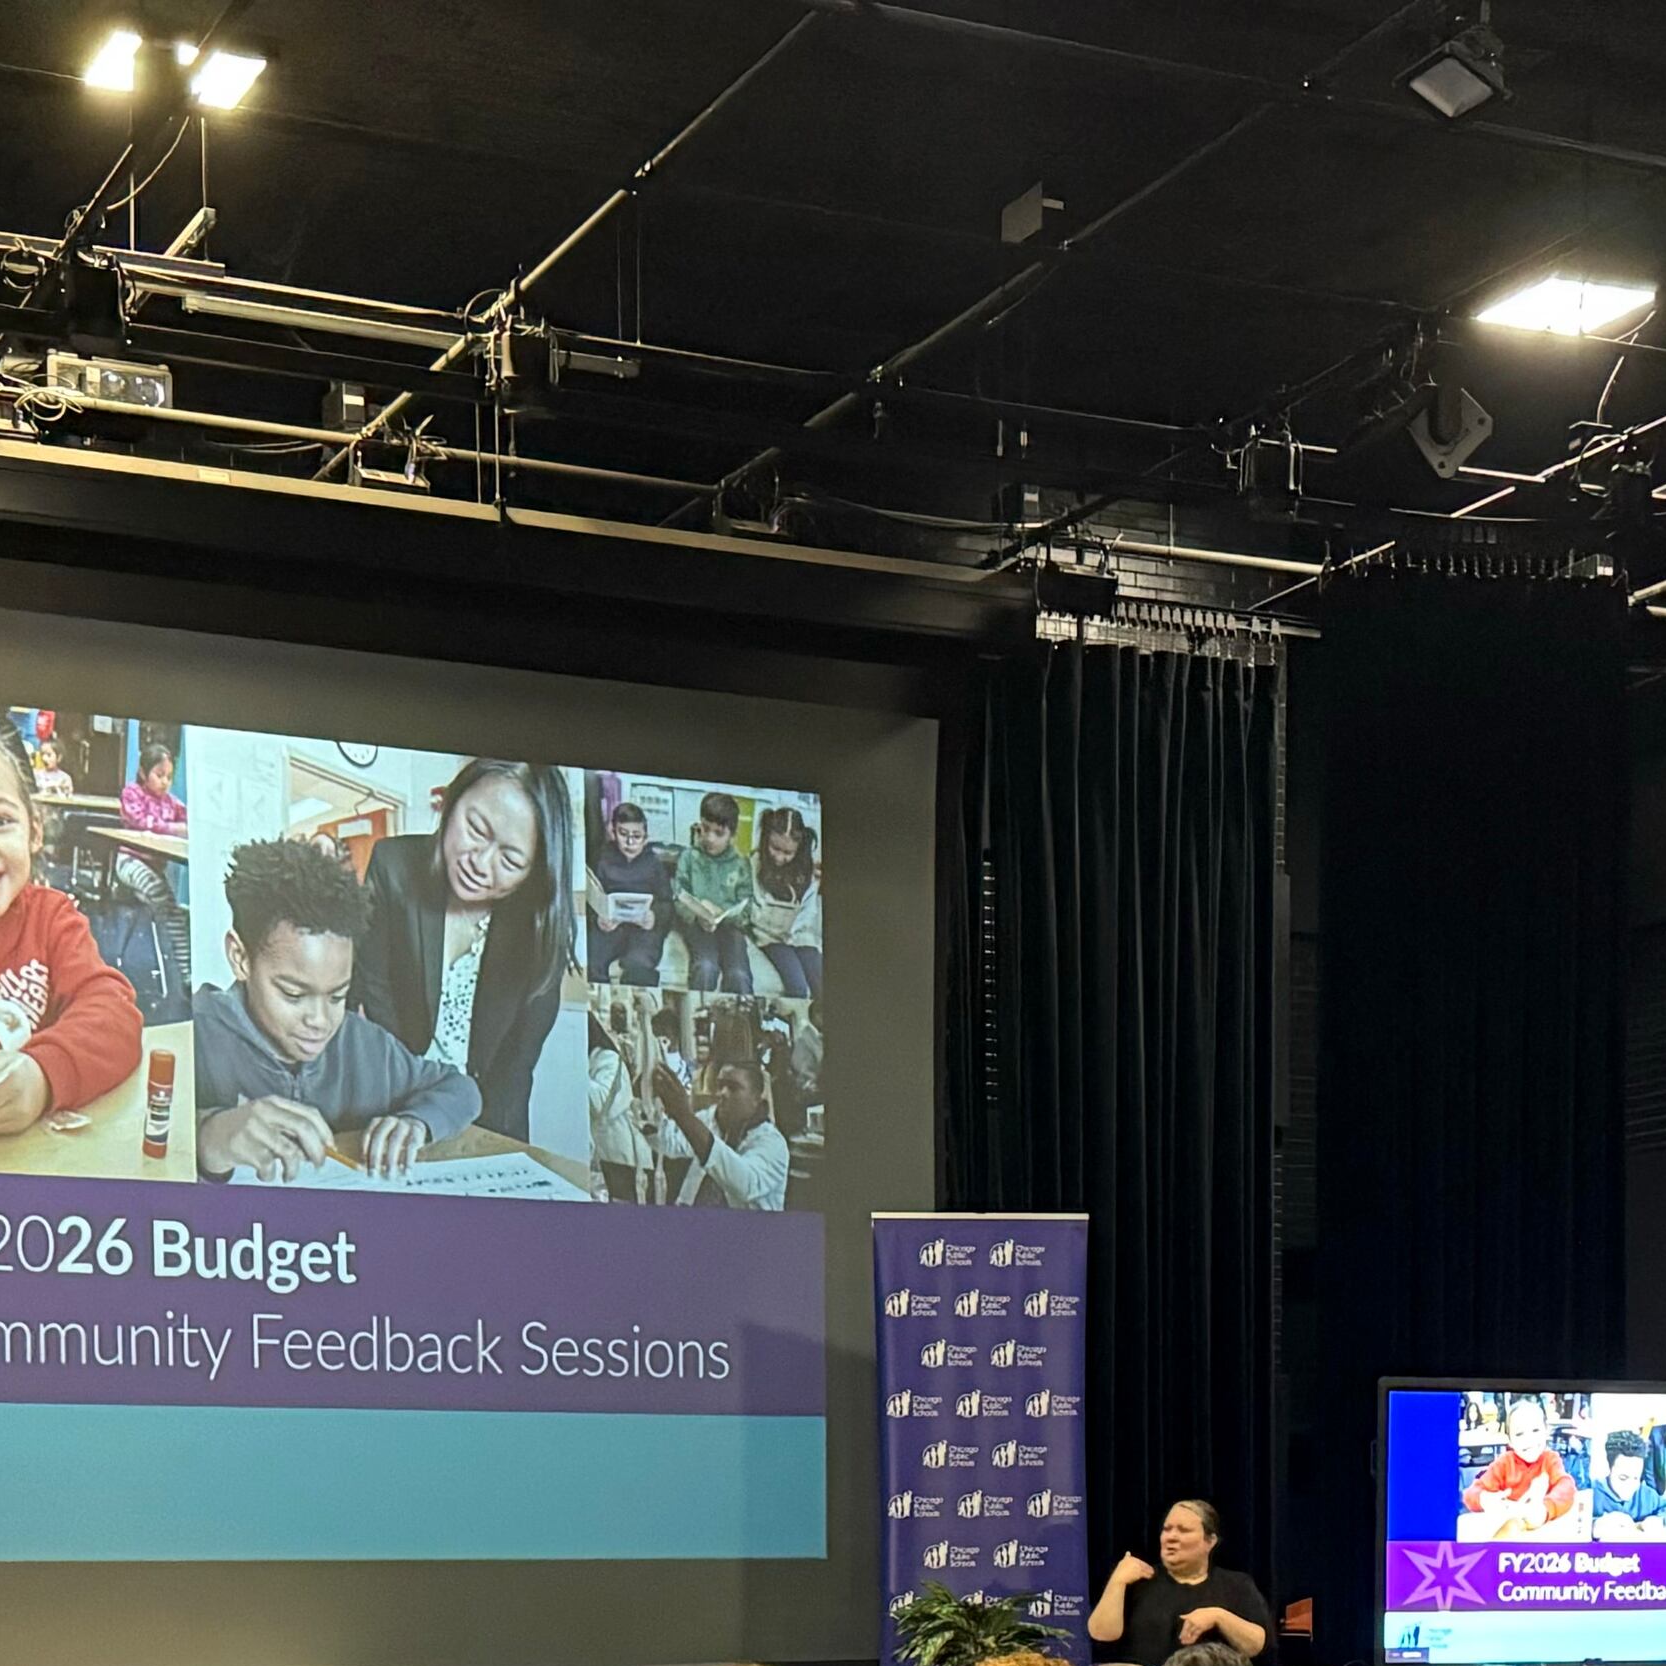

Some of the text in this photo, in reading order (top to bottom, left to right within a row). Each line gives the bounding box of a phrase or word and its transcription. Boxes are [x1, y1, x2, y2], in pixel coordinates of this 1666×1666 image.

[153, 1219, 357, 1293] Budget
[253, 1313, 503, 1374] Feedback
[520, 1321, 729, 1380] Sessions
[1497, 1552, 1641, 1577] FY2026 Budget
[1497, 1580, 1601, 1604] Community
